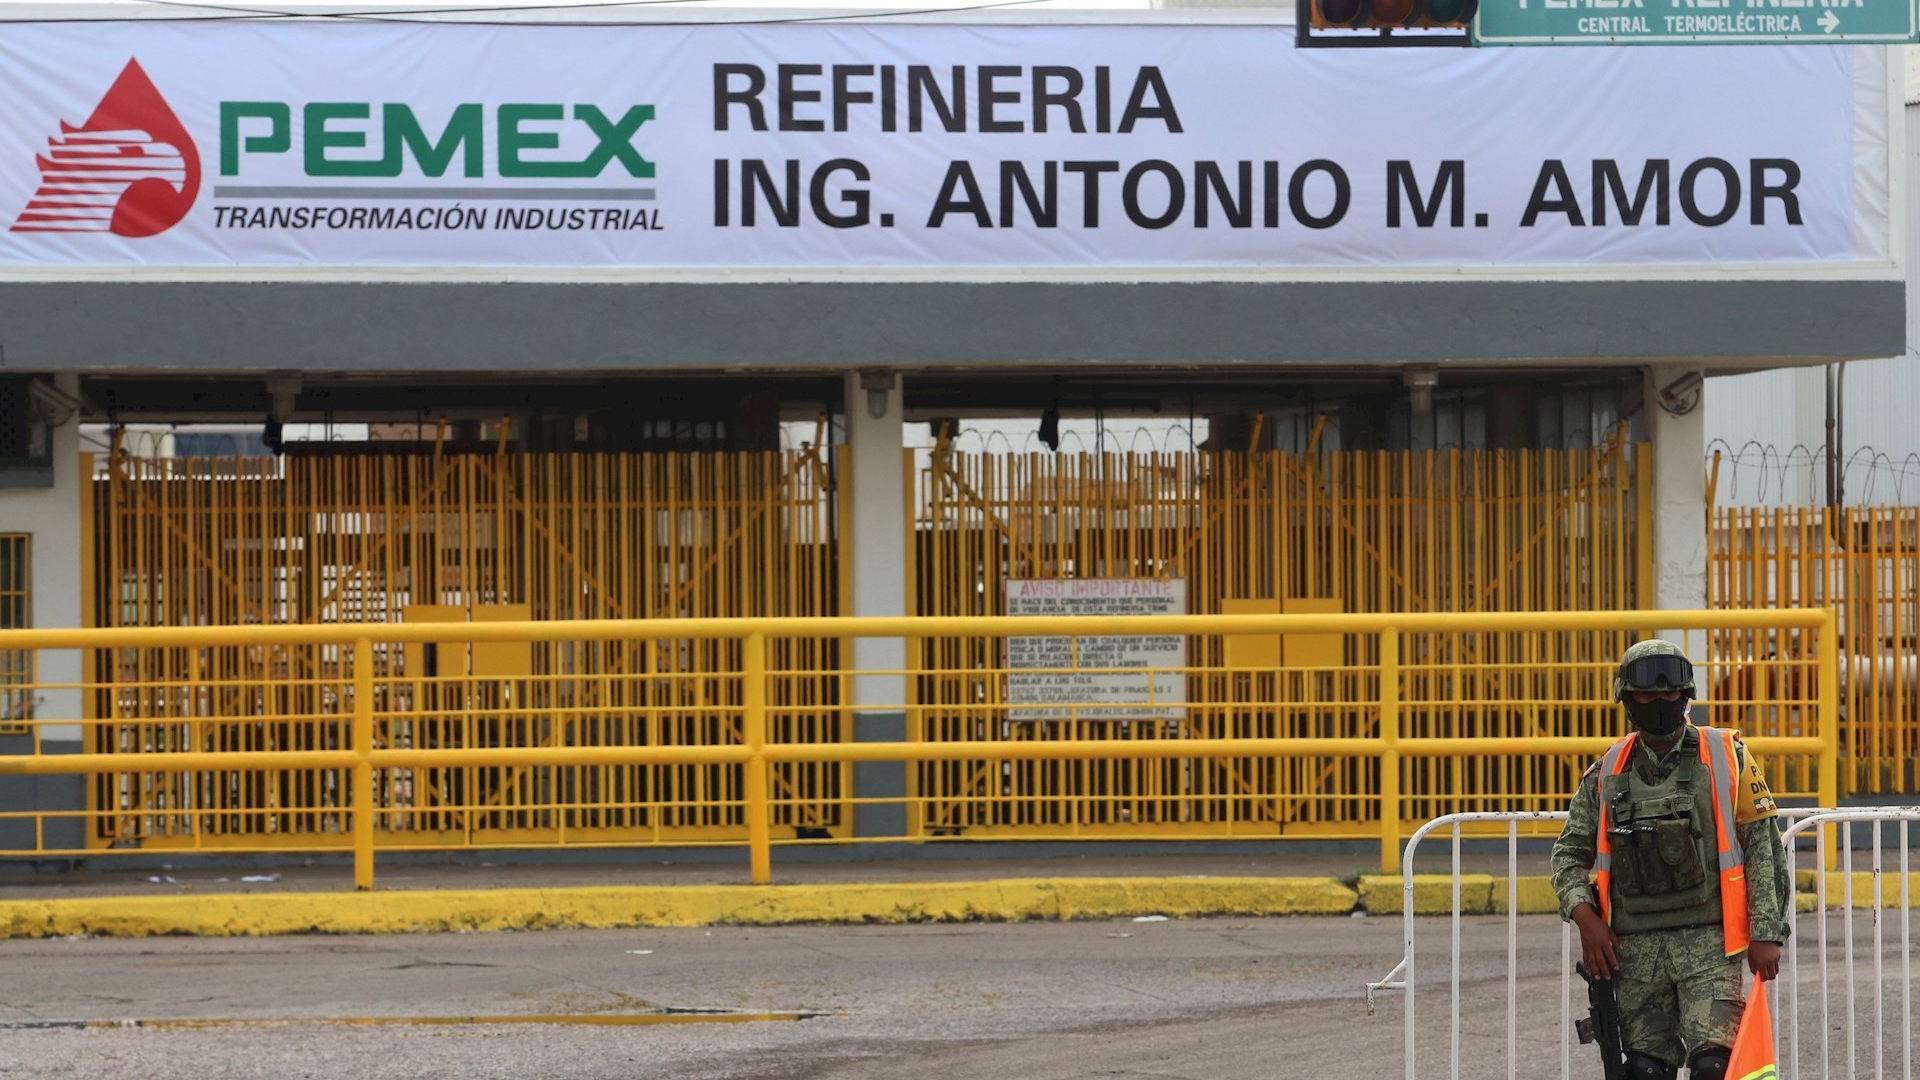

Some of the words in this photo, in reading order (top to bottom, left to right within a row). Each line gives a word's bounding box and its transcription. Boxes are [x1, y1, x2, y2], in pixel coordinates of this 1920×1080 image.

[1578, 16, 1651, 33] CENTRAL
[1664, 11, 1801, 33] TERMOELÉCTRICA
[713, 63, 1184, 134] REFINERIA
[219, 101, 656, 179] PEMEX
[213, 204, 487, 231] TRANSFORMACIÓN
[494, 207, 664, 232] INDUSTRIAL
[714, 158, 894, 229] ING.
[927, 157, 1351, 230] ANTONIO
[1387, 159, 1489, 228] M.
[1520, 157, 1804, 228] AMOR
[1020, 581, 1063, 597] AVISO
[1072, 580, 1172, 597] IMPORTANTE
